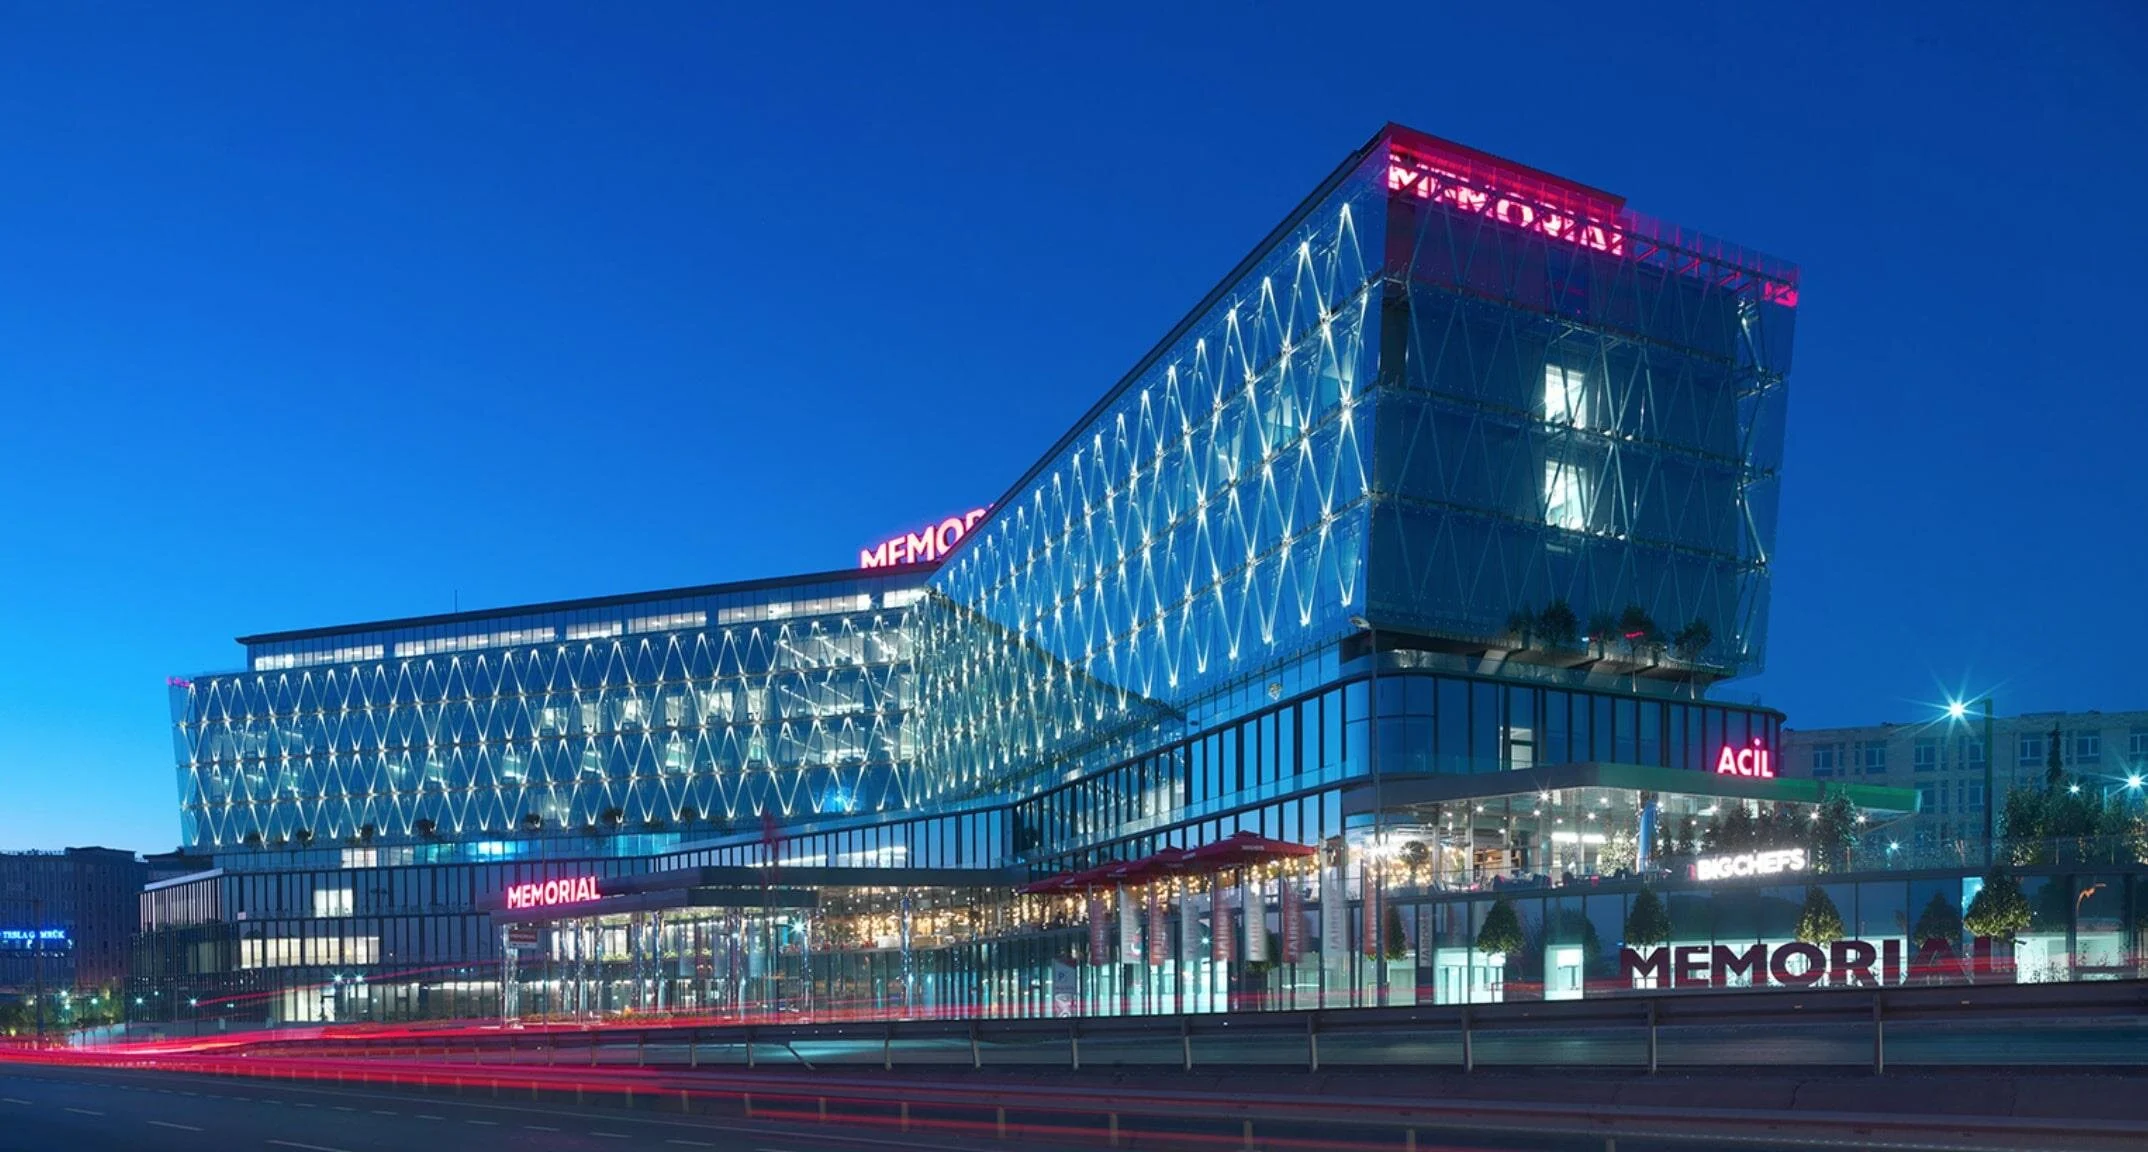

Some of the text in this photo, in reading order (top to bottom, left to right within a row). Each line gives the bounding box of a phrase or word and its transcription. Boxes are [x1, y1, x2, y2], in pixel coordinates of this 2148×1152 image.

[1717, 738, 1774, 778] ACİL
[1697, 848, 1806, 881] BIGCHEFS
[507, 876, 601, 910] MEMORIAL
